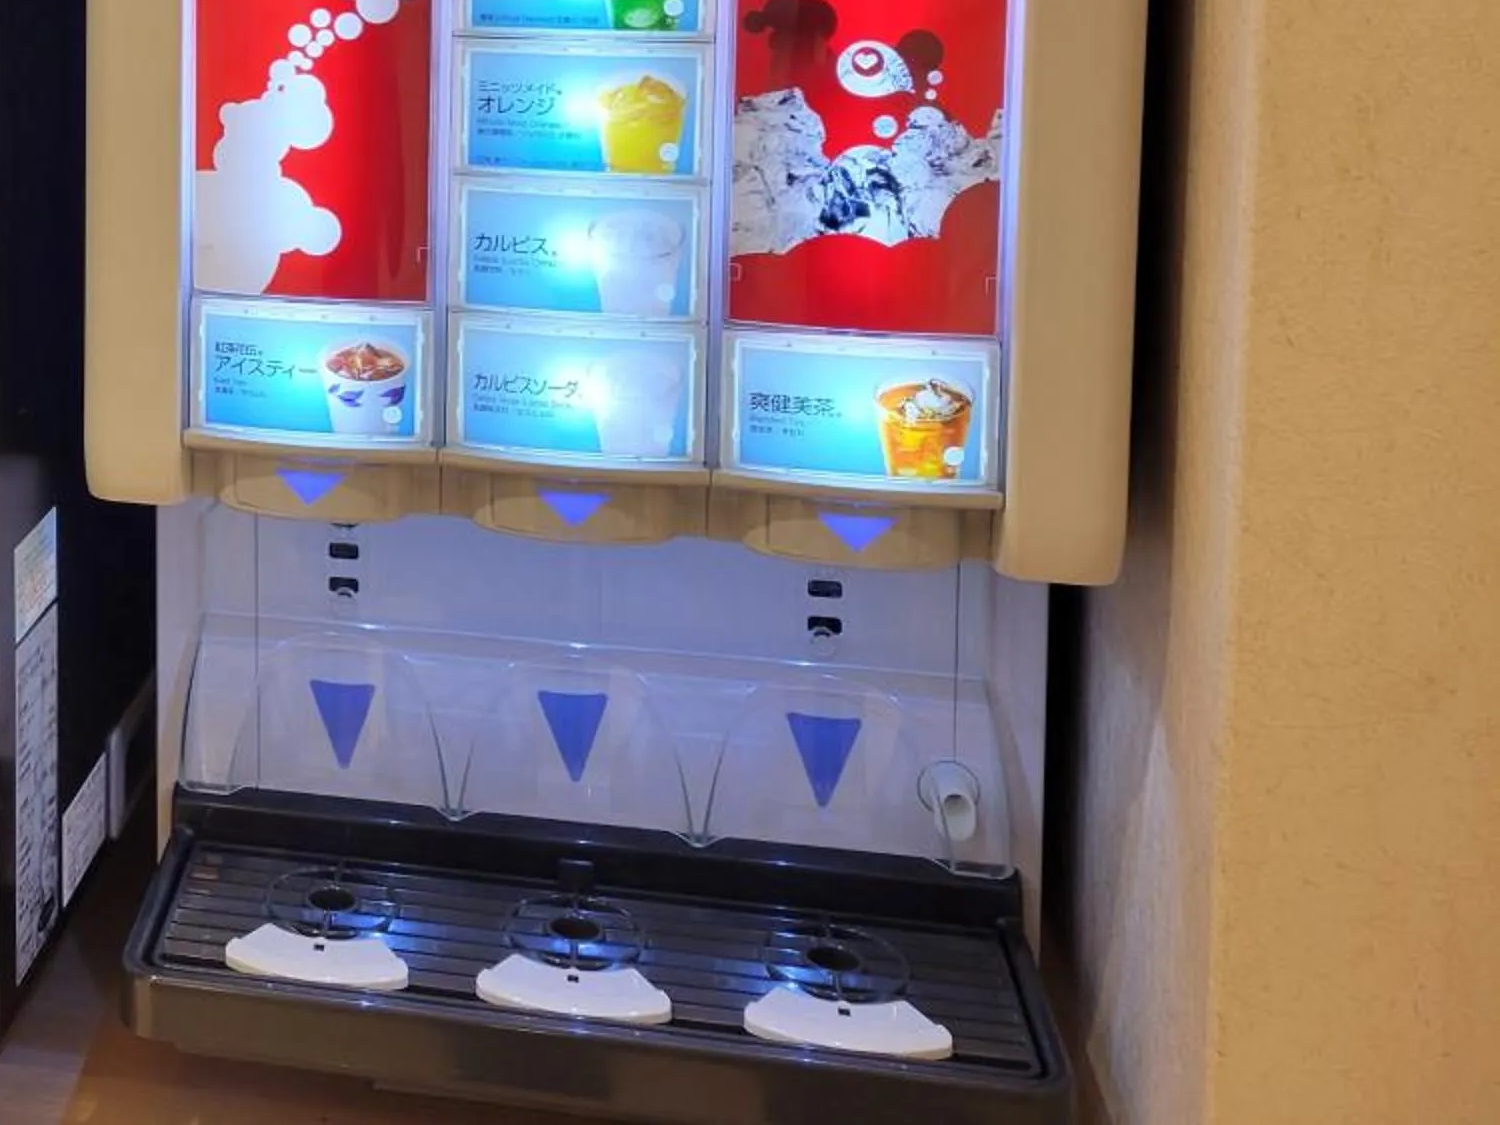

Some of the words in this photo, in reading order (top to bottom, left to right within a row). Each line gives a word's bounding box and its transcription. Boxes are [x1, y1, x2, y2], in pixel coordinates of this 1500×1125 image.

[476, 94, 556, 116] オレンジ
[474, 232, 550, 256] カルピス
[214, 354, 318, 380] アイスティー
[473, 373, 579, 399] カルピスソーダ
[749, 391, 836, 416] 爽健美茶
